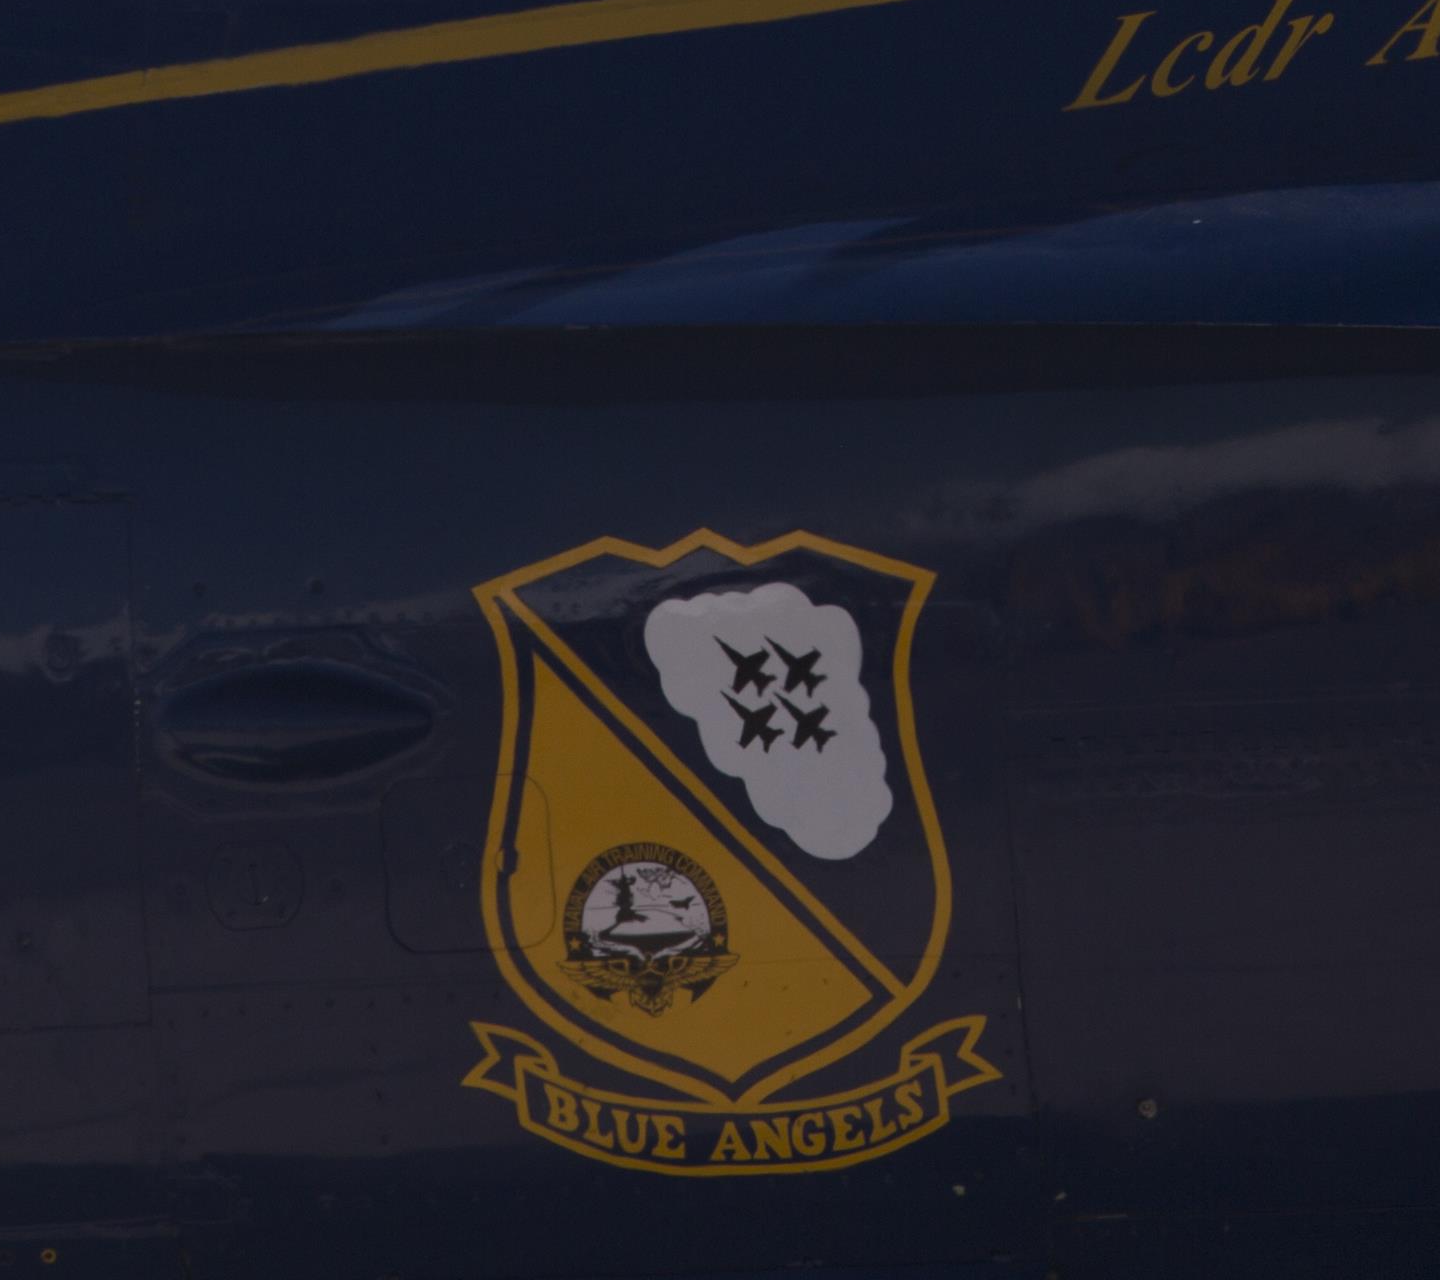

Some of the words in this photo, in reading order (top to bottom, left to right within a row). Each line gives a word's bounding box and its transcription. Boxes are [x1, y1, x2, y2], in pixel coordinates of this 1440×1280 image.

[604, 843, 675, 865] TRAINING
[676, 853, 727, 927] COMMAND
[544, 1082, 686, 1159] BLUE
[709, 1080, 924, 1162] ANGELS
